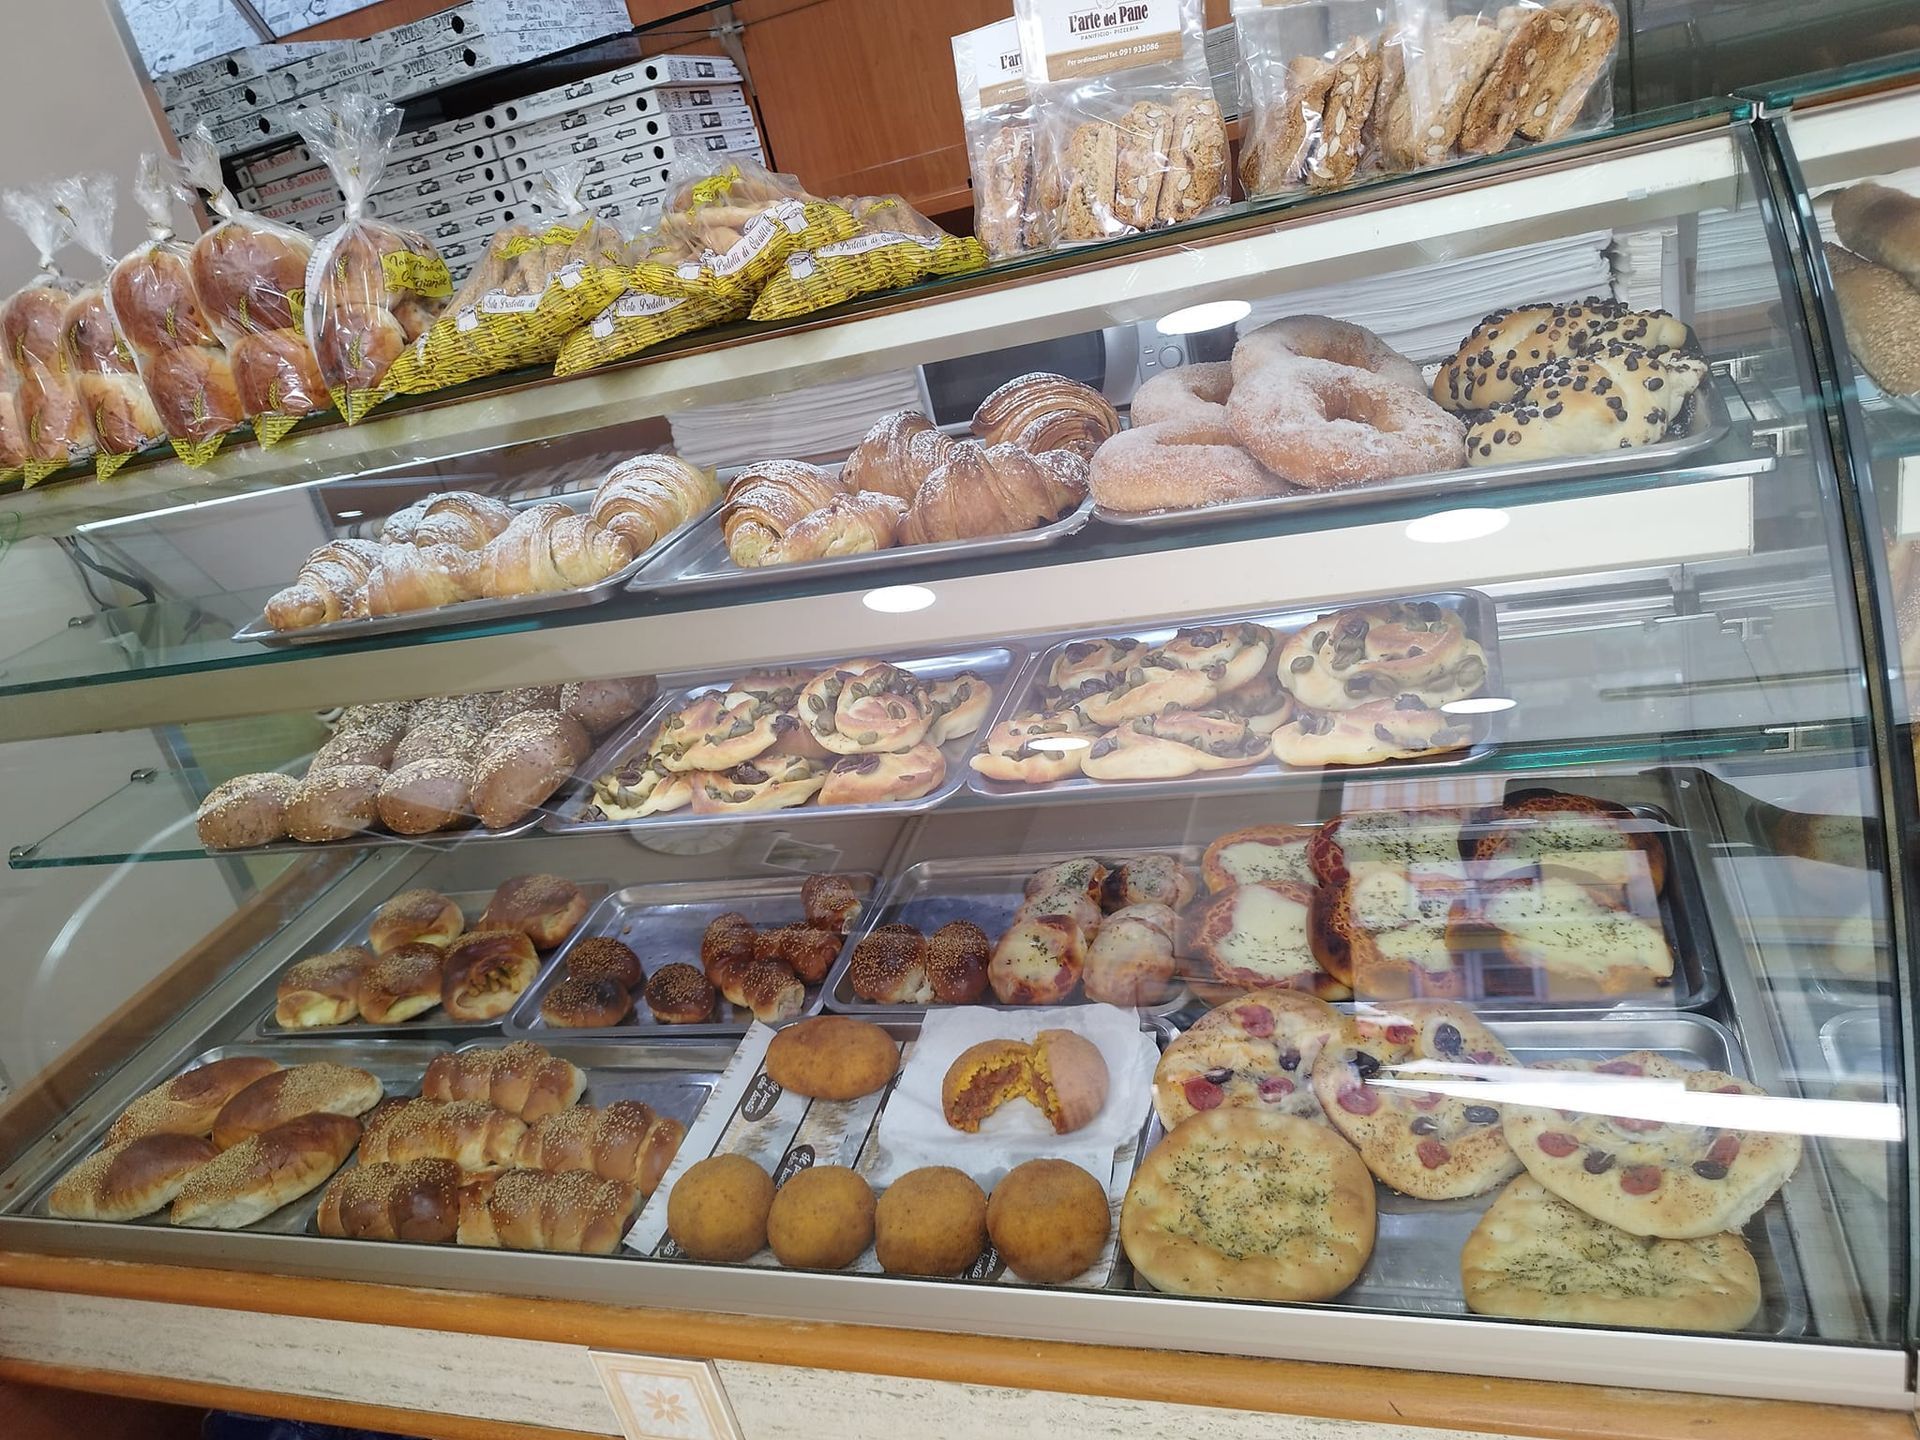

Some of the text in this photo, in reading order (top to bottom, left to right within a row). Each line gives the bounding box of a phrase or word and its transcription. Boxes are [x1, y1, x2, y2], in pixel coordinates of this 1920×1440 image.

[1068, 4, 1149, 33] L'arte del Pane
[339, 60, 376, 78] TRATTORIA
[1000, 53, 1021, 69] L'ar
